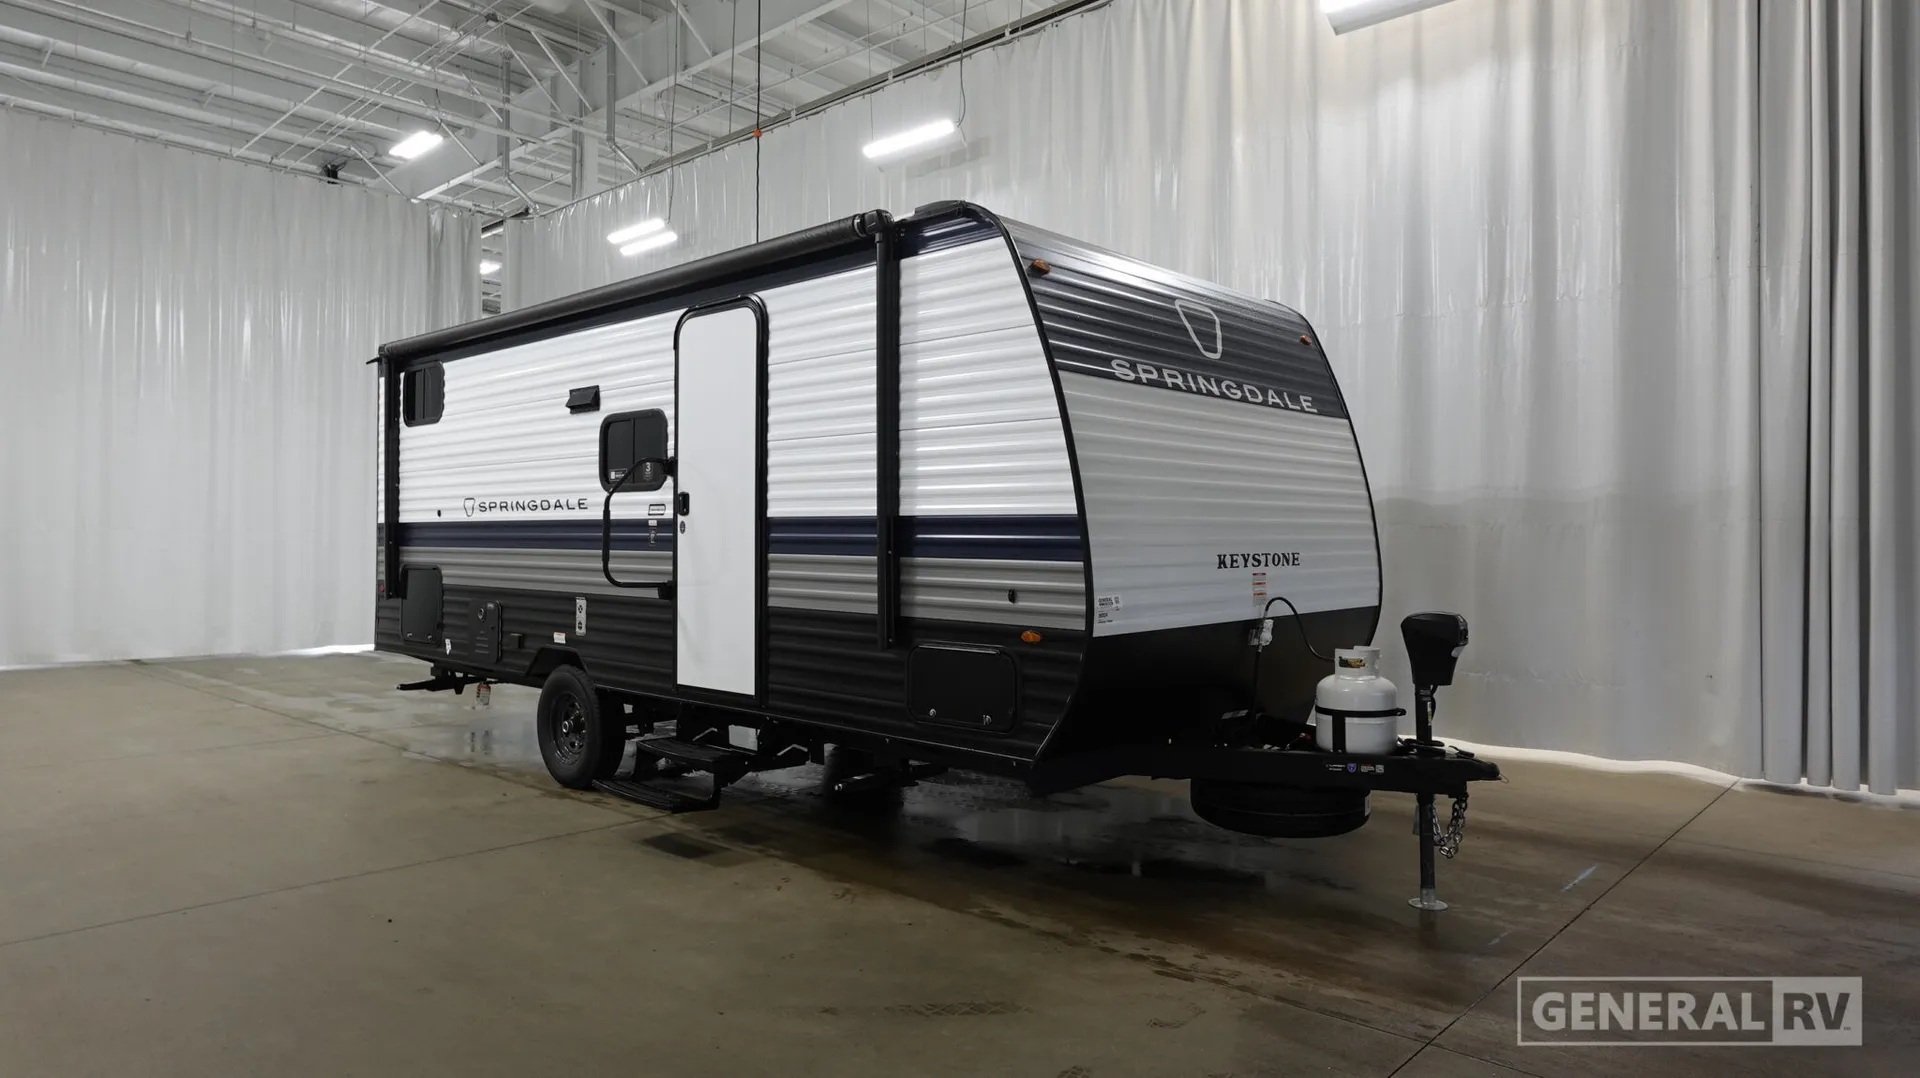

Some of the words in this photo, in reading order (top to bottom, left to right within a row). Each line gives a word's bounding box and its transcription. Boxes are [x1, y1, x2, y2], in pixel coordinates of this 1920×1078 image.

[1111, 359, 1318, 413] SPRINGDALE
[478, 498, 588, 513] SPRINGDALE
[1217, 552, 1300, 569] KEYSTONE
